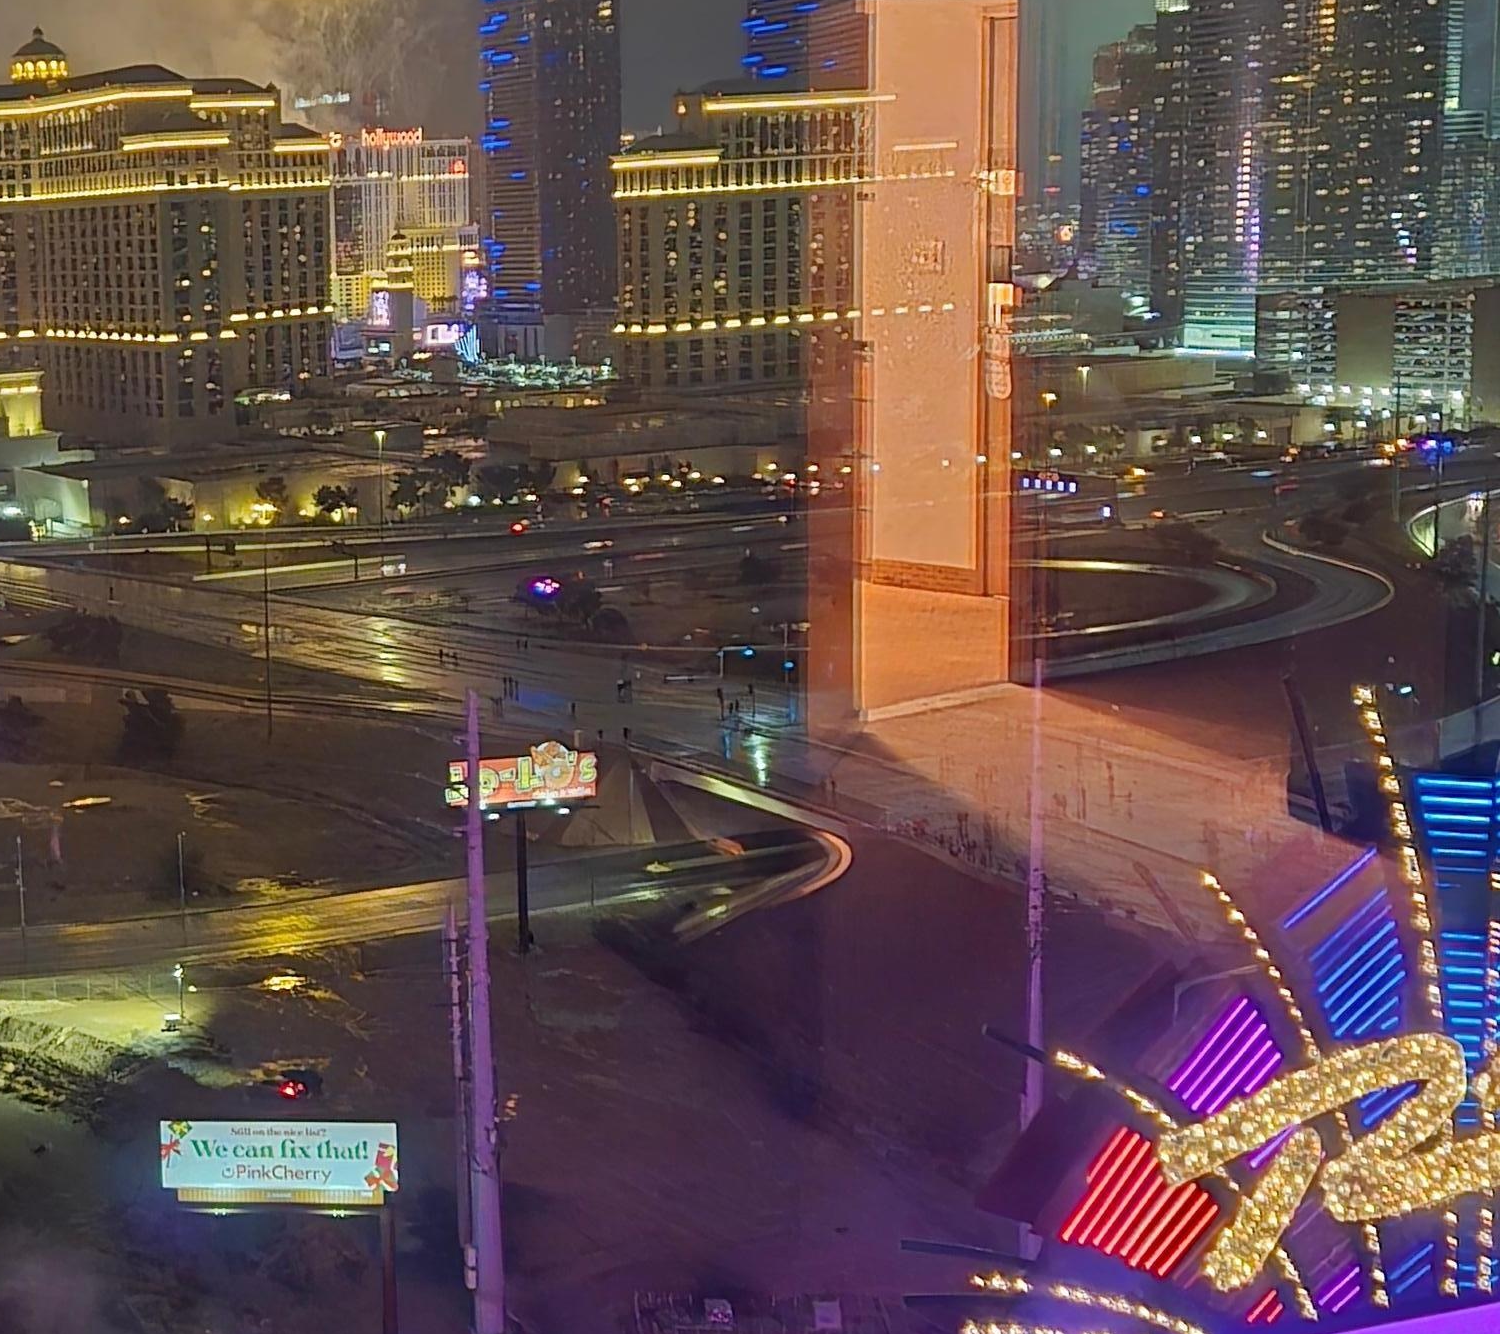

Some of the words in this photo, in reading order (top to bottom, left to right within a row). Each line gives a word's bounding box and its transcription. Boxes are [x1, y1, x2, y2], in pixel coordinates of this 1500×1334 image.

[361, 127, 422, 150] hollywood
[230, 1127, 251, 1136] Still
[266, 1127, 282, 1136] the
[283, 1127, 304, 1137] nice
[190, 1139, 228, 1159] We
[233, 1144, 274, 1158] can
[280, 1138, 311, 1159] fix
[317, 1139, 369, 1160] that!
[236, 1164, 332, 1184] PinkCherry
